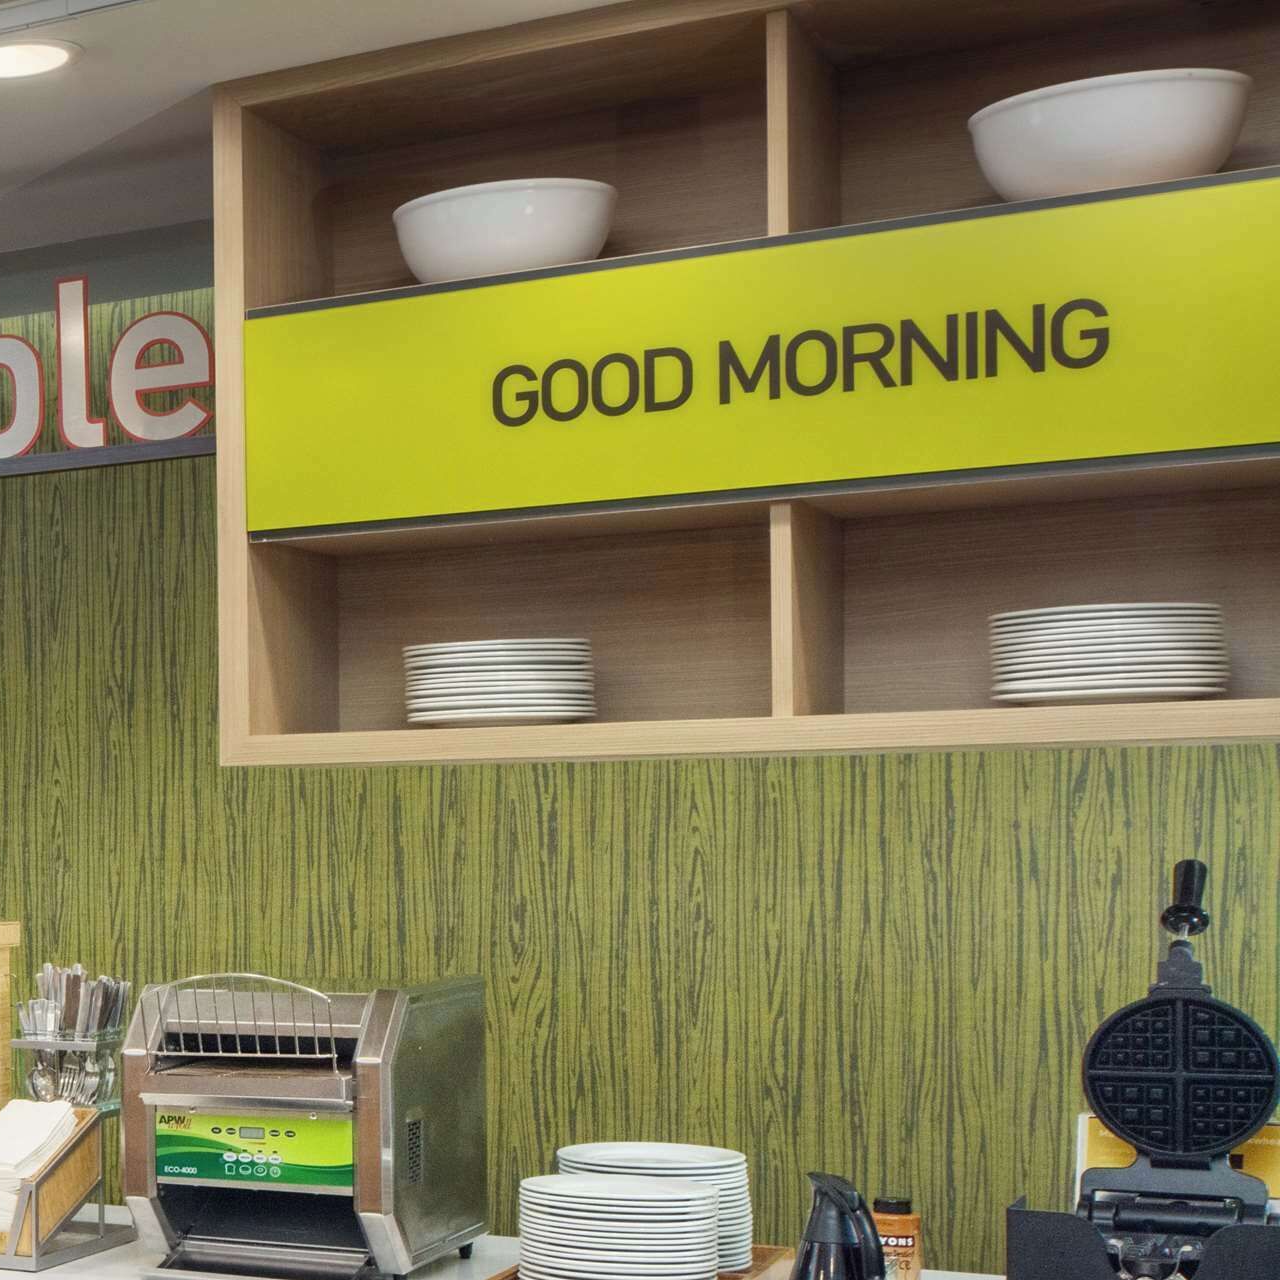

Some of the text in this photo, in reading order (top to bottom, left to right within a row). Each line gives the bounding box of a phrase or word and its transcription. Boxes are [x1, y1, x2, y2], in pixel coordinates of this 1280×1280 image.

[491, 297, 1111, 428] GOOD MORNING
[159, 1114, 186, 1125] APW
[164, 1165, 198, 1175] ECO-4000
[879, 1236, 914, 1247] YONS
